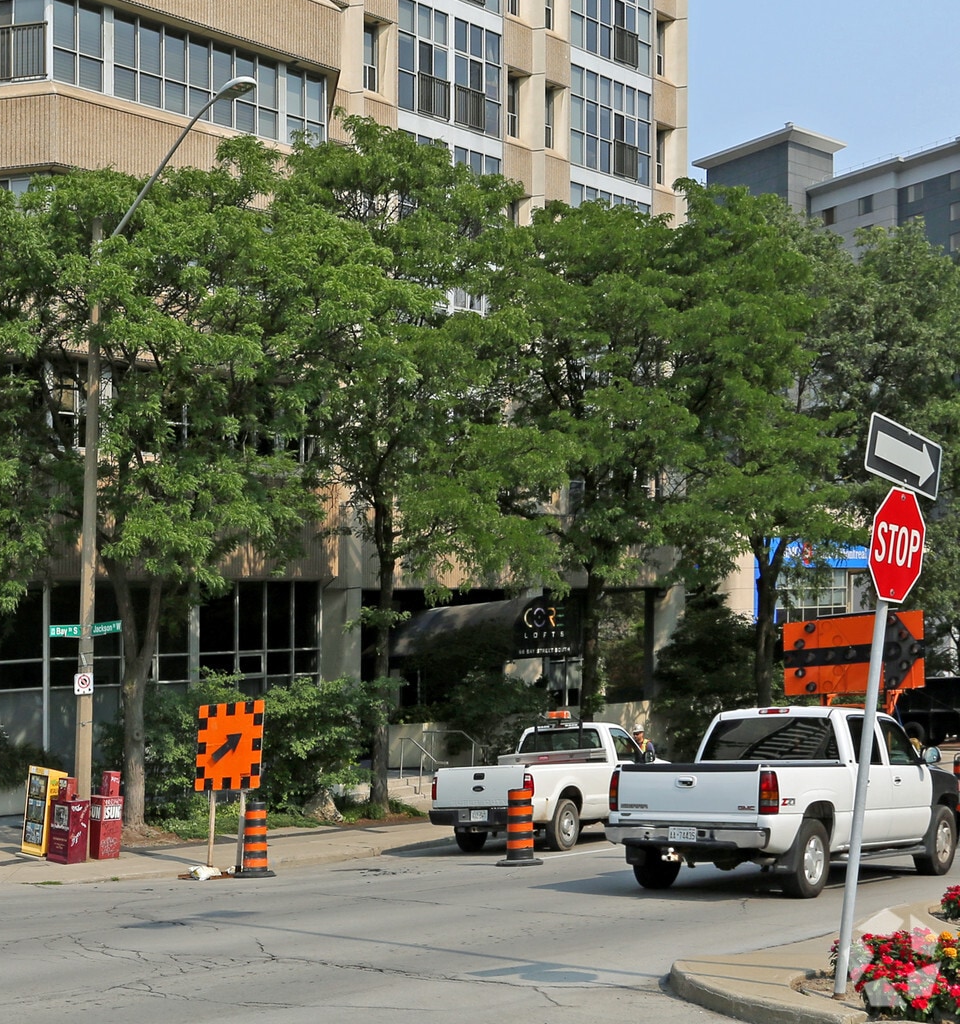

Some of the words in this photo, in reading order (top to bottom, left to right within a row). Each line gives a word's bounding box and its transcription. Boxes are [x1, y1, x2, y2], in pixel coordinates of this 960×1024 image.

[874, 521, 921, 568] STOP
[523, 607, 565, 628] CORE
[56, 627, 68, 637] Bay
[73, 626, 78, 635] S
[93, 624, 113, 633] Jackson
[116, 621, 122, 631] W
[524, 631, 565, 639] LOFTS
[91, 806, 101, 820] UN
[105, 805, 122, 819] SUN
